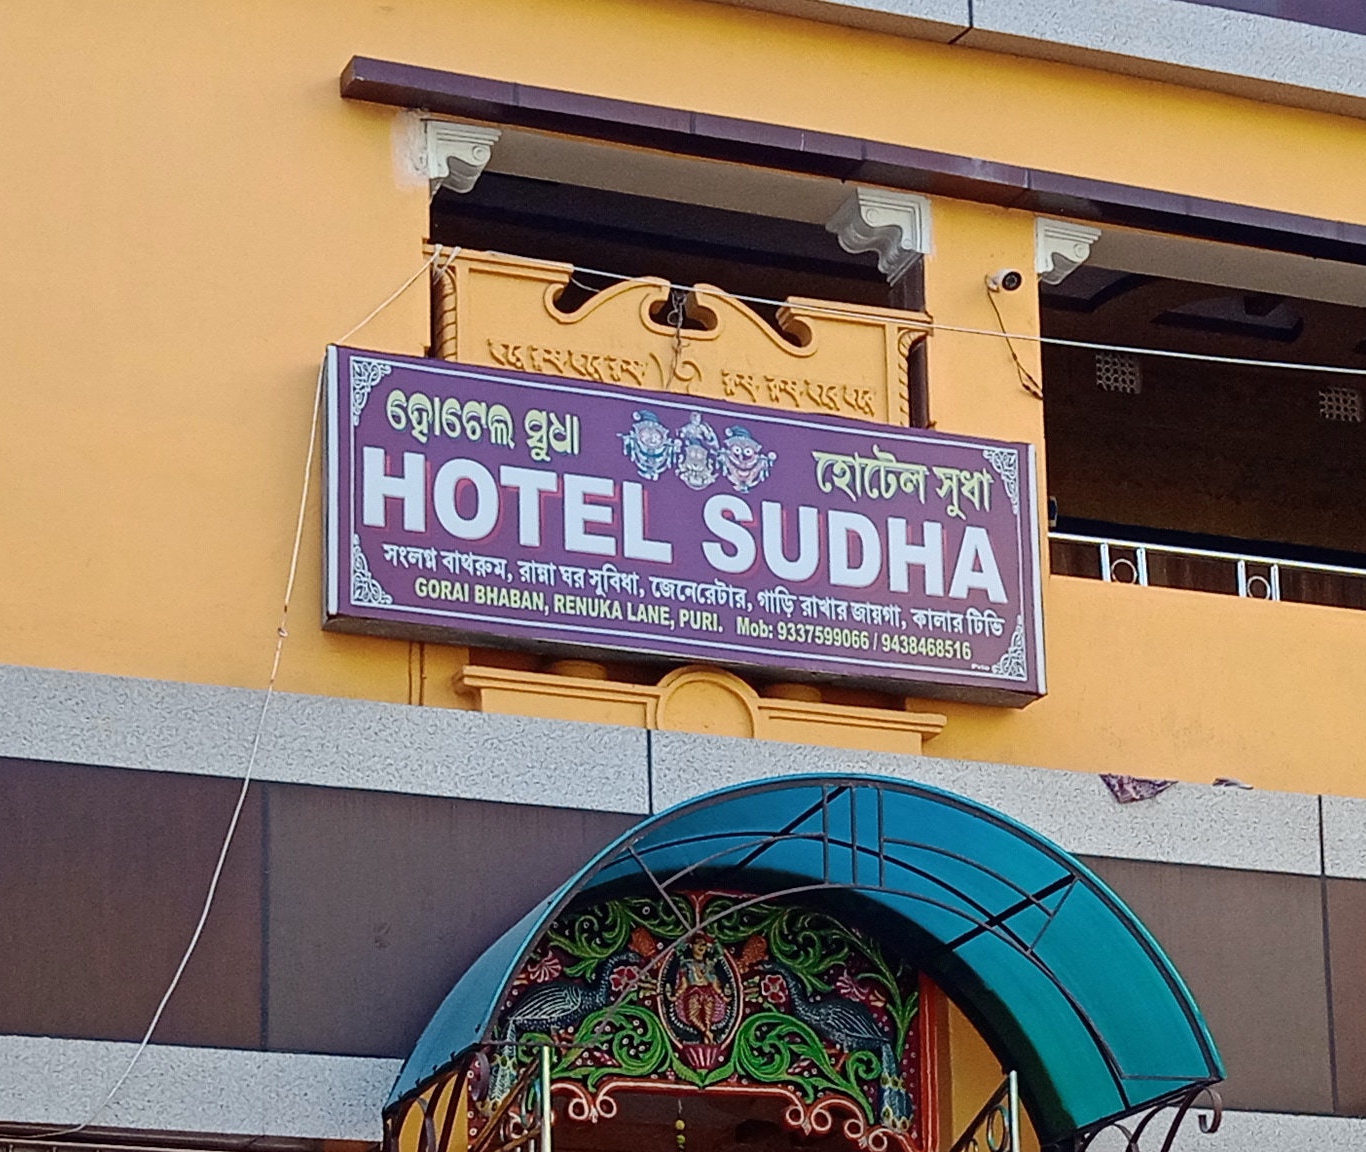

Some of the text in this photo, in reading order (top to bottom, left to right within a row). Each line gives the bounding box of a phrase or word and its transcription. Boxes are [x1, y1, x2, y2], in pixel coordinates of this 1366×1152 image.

[387, 389, 580, 461] ହୋଟେଲ ସୁଧା
[812, 445, 994, 520] হোটেল সুধা
[363, 446, 1009, 604] HOTEL SUDHA
[415, 577, 972, 660] GORAI BHABAN, RENUKA LANE, PURI. Mob: 9337599066 / 9438468516
[439, 549, 513, 583] বাথরুম,
[516, 560, 557, 587] রান্না
[558, 565, 586, 589] ঘর
[587, 563, 645, 598] সুবিধা,
[799, 593, 848, 621] রাখার
[910, 608, 964, 635] কালার
[965, 607, 1005, 637] টিভি
